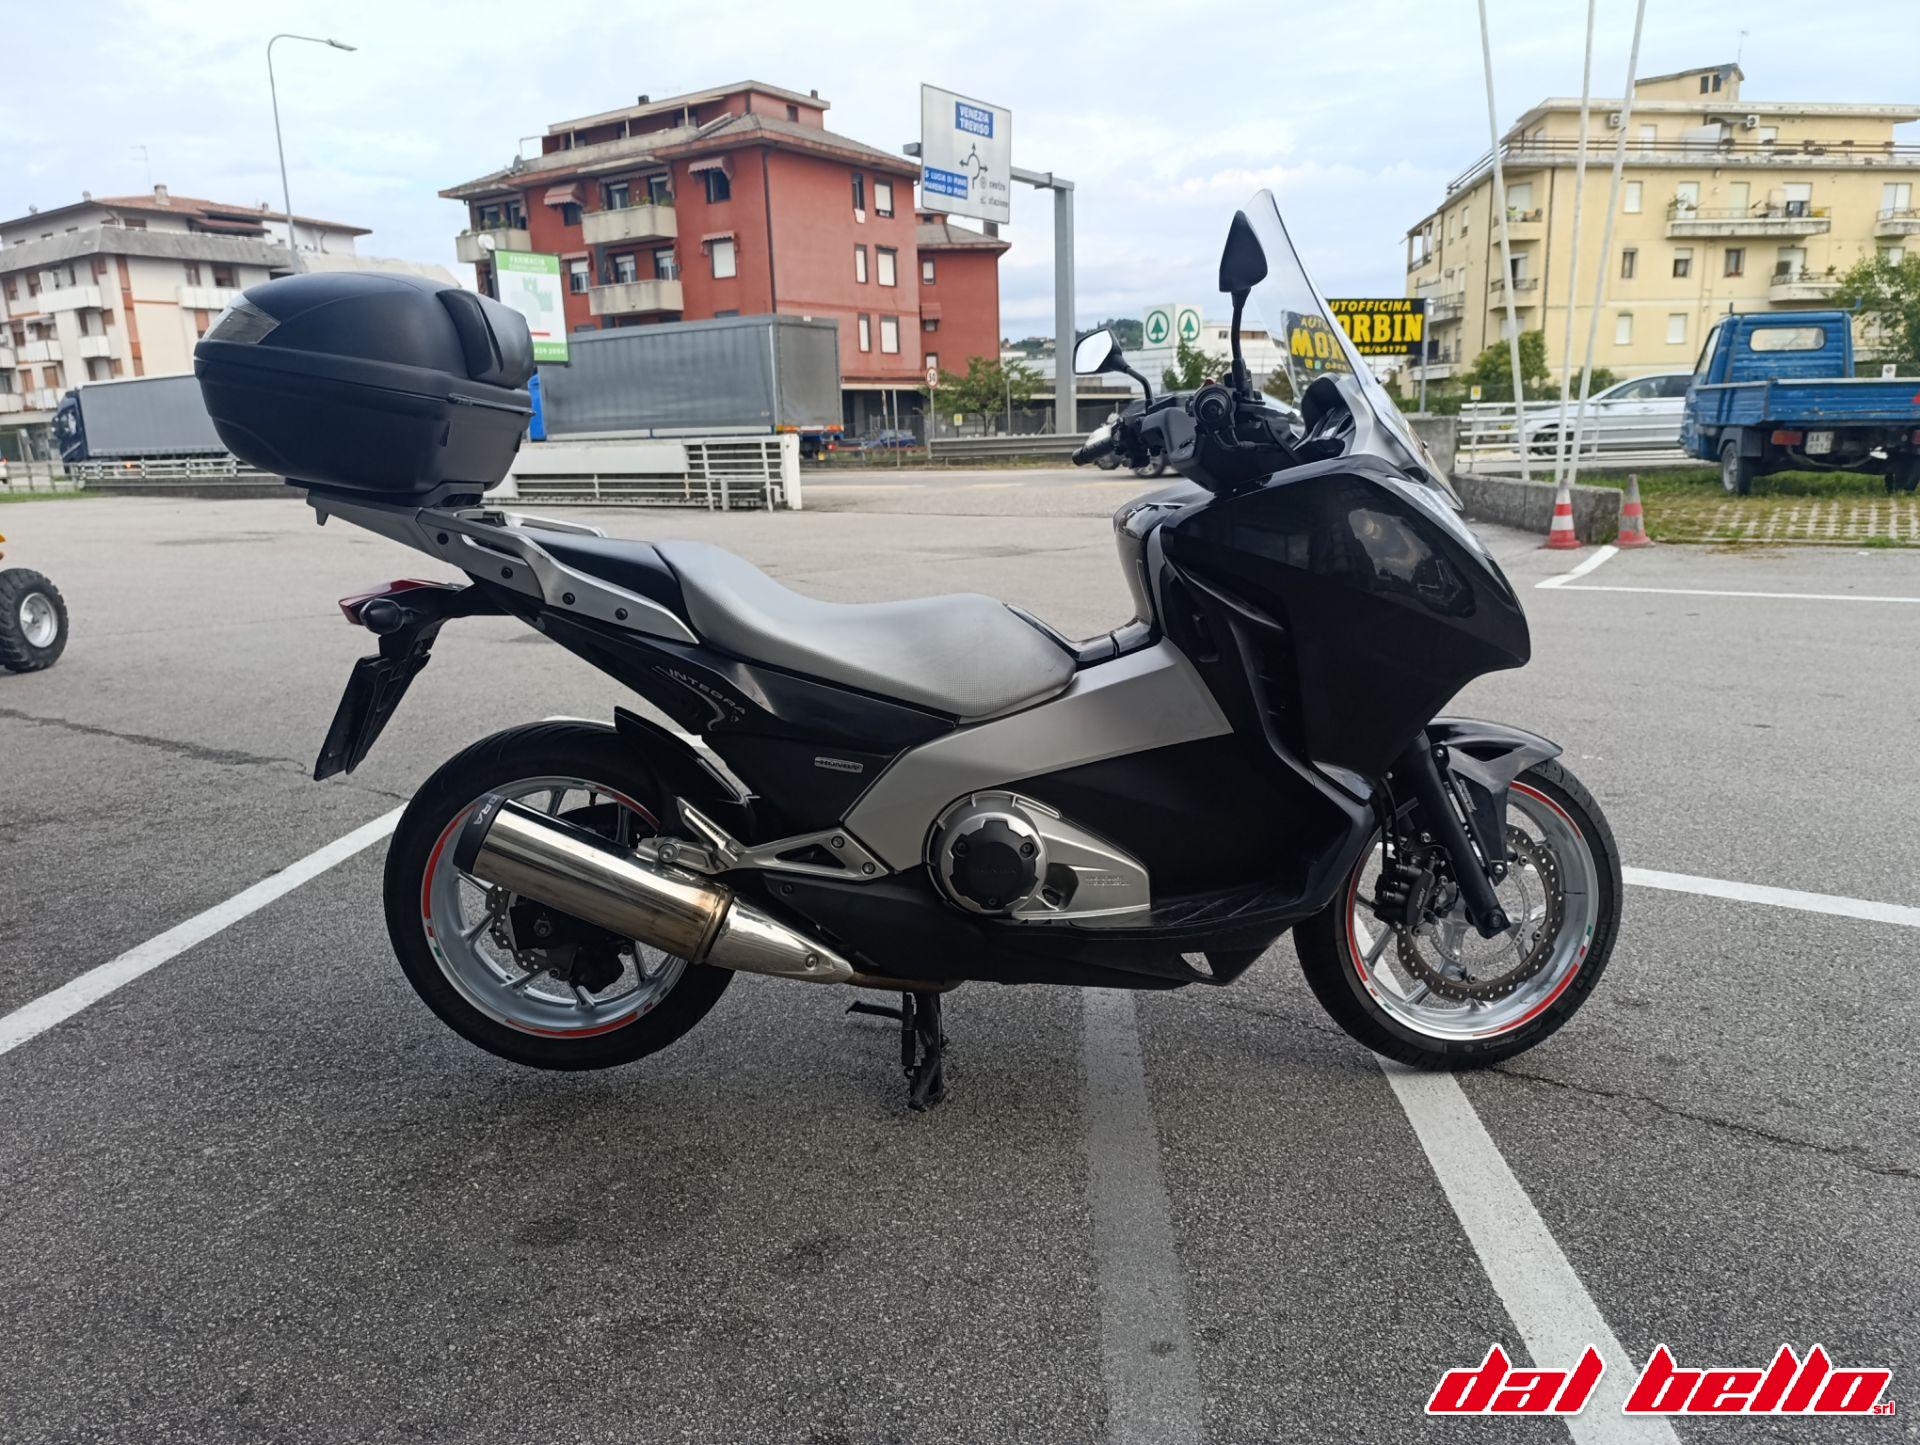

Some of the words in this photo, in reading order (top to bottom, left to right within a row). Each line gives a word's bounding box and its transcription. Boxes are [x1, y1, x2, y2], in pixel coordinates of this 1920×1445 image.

[960, 105, 989, 123] VENEZIA
[960, 118, 989, 135] TREVISO
[1330, 301, 1411, 312] UTOFFICINA
[1336, 314, 1424, 343] ORBIN
[669, 669, 746, 715] INTEGRA
